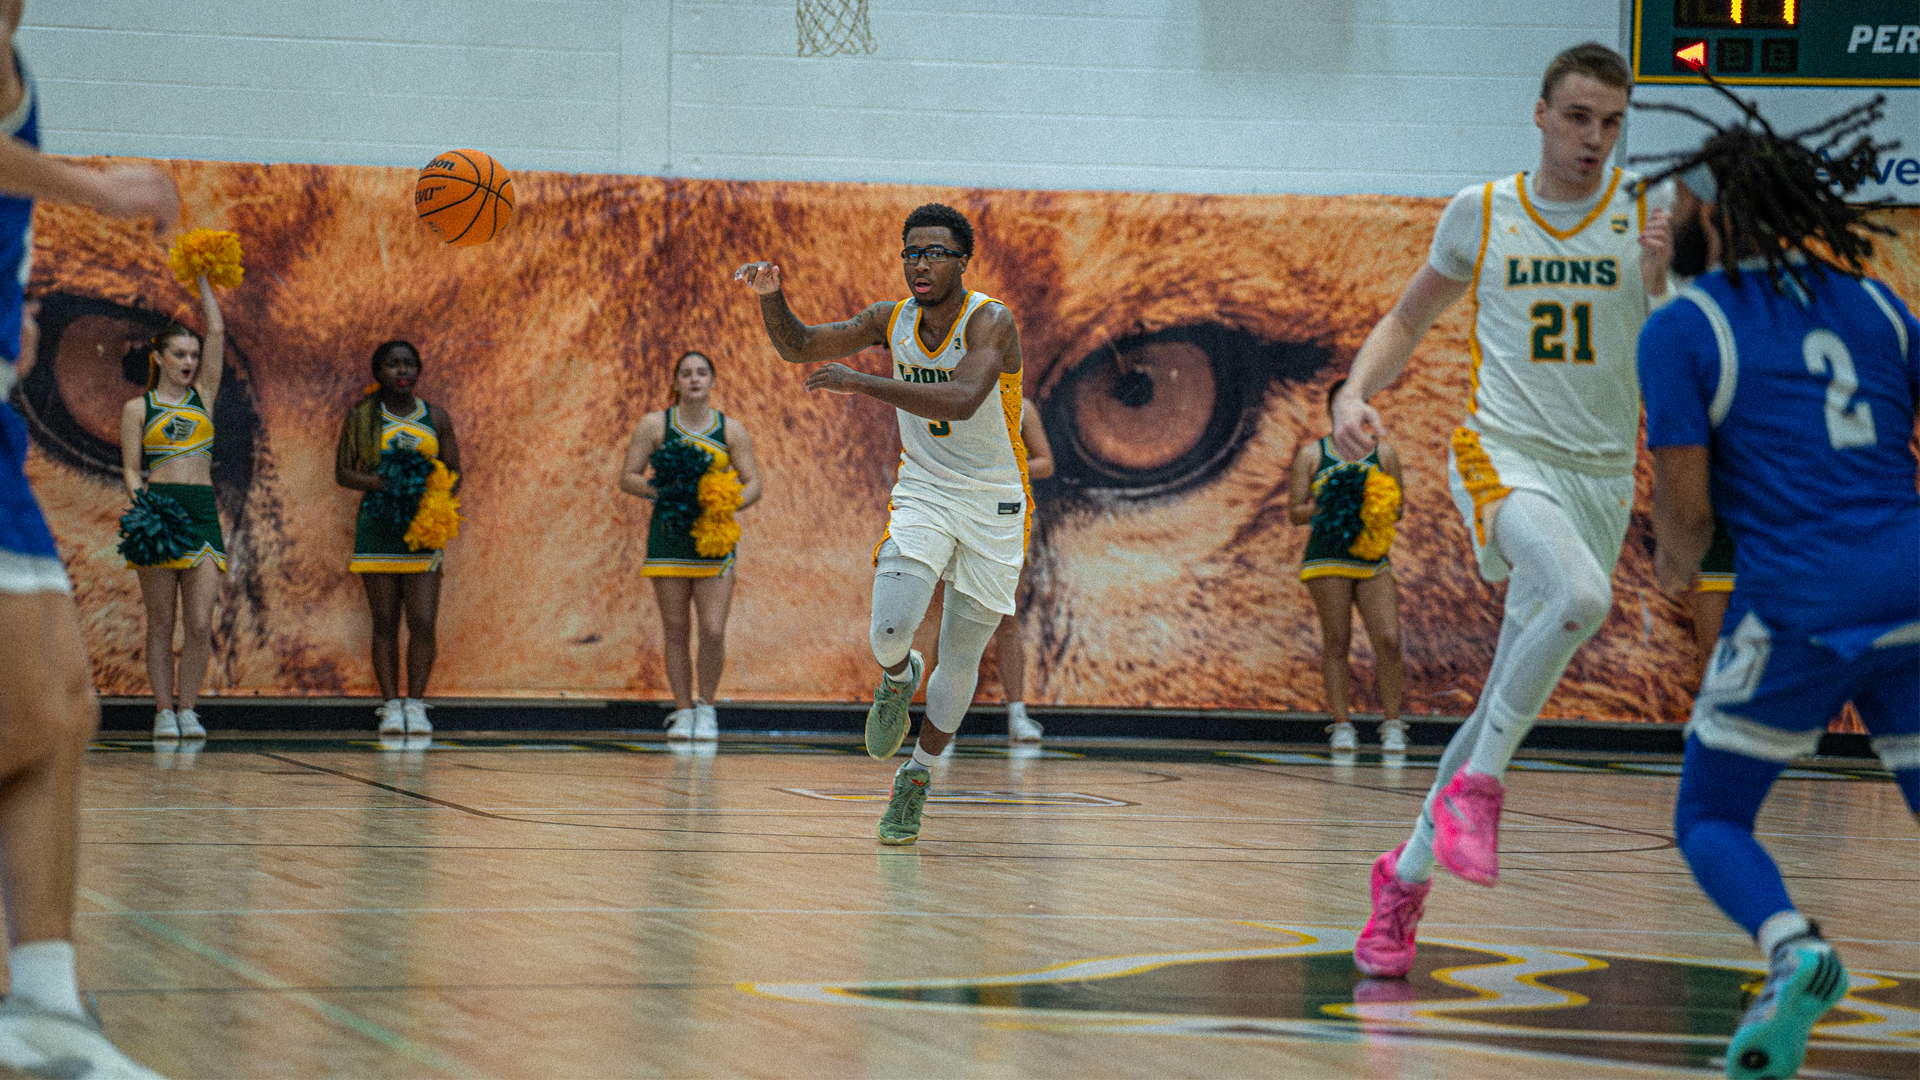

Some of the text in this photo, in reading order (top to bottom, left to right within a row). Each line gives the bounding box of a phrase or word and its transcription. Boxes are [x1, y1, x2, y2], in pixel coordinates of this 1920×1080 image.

[1847, 24, 1920, 54] PER
[1505, 256, 1620, 290] LIONS
[1529, 300, 1596, 364] 21
[897, 361, 955, 384] LION
[1802, 328, 1877, 450] 2
